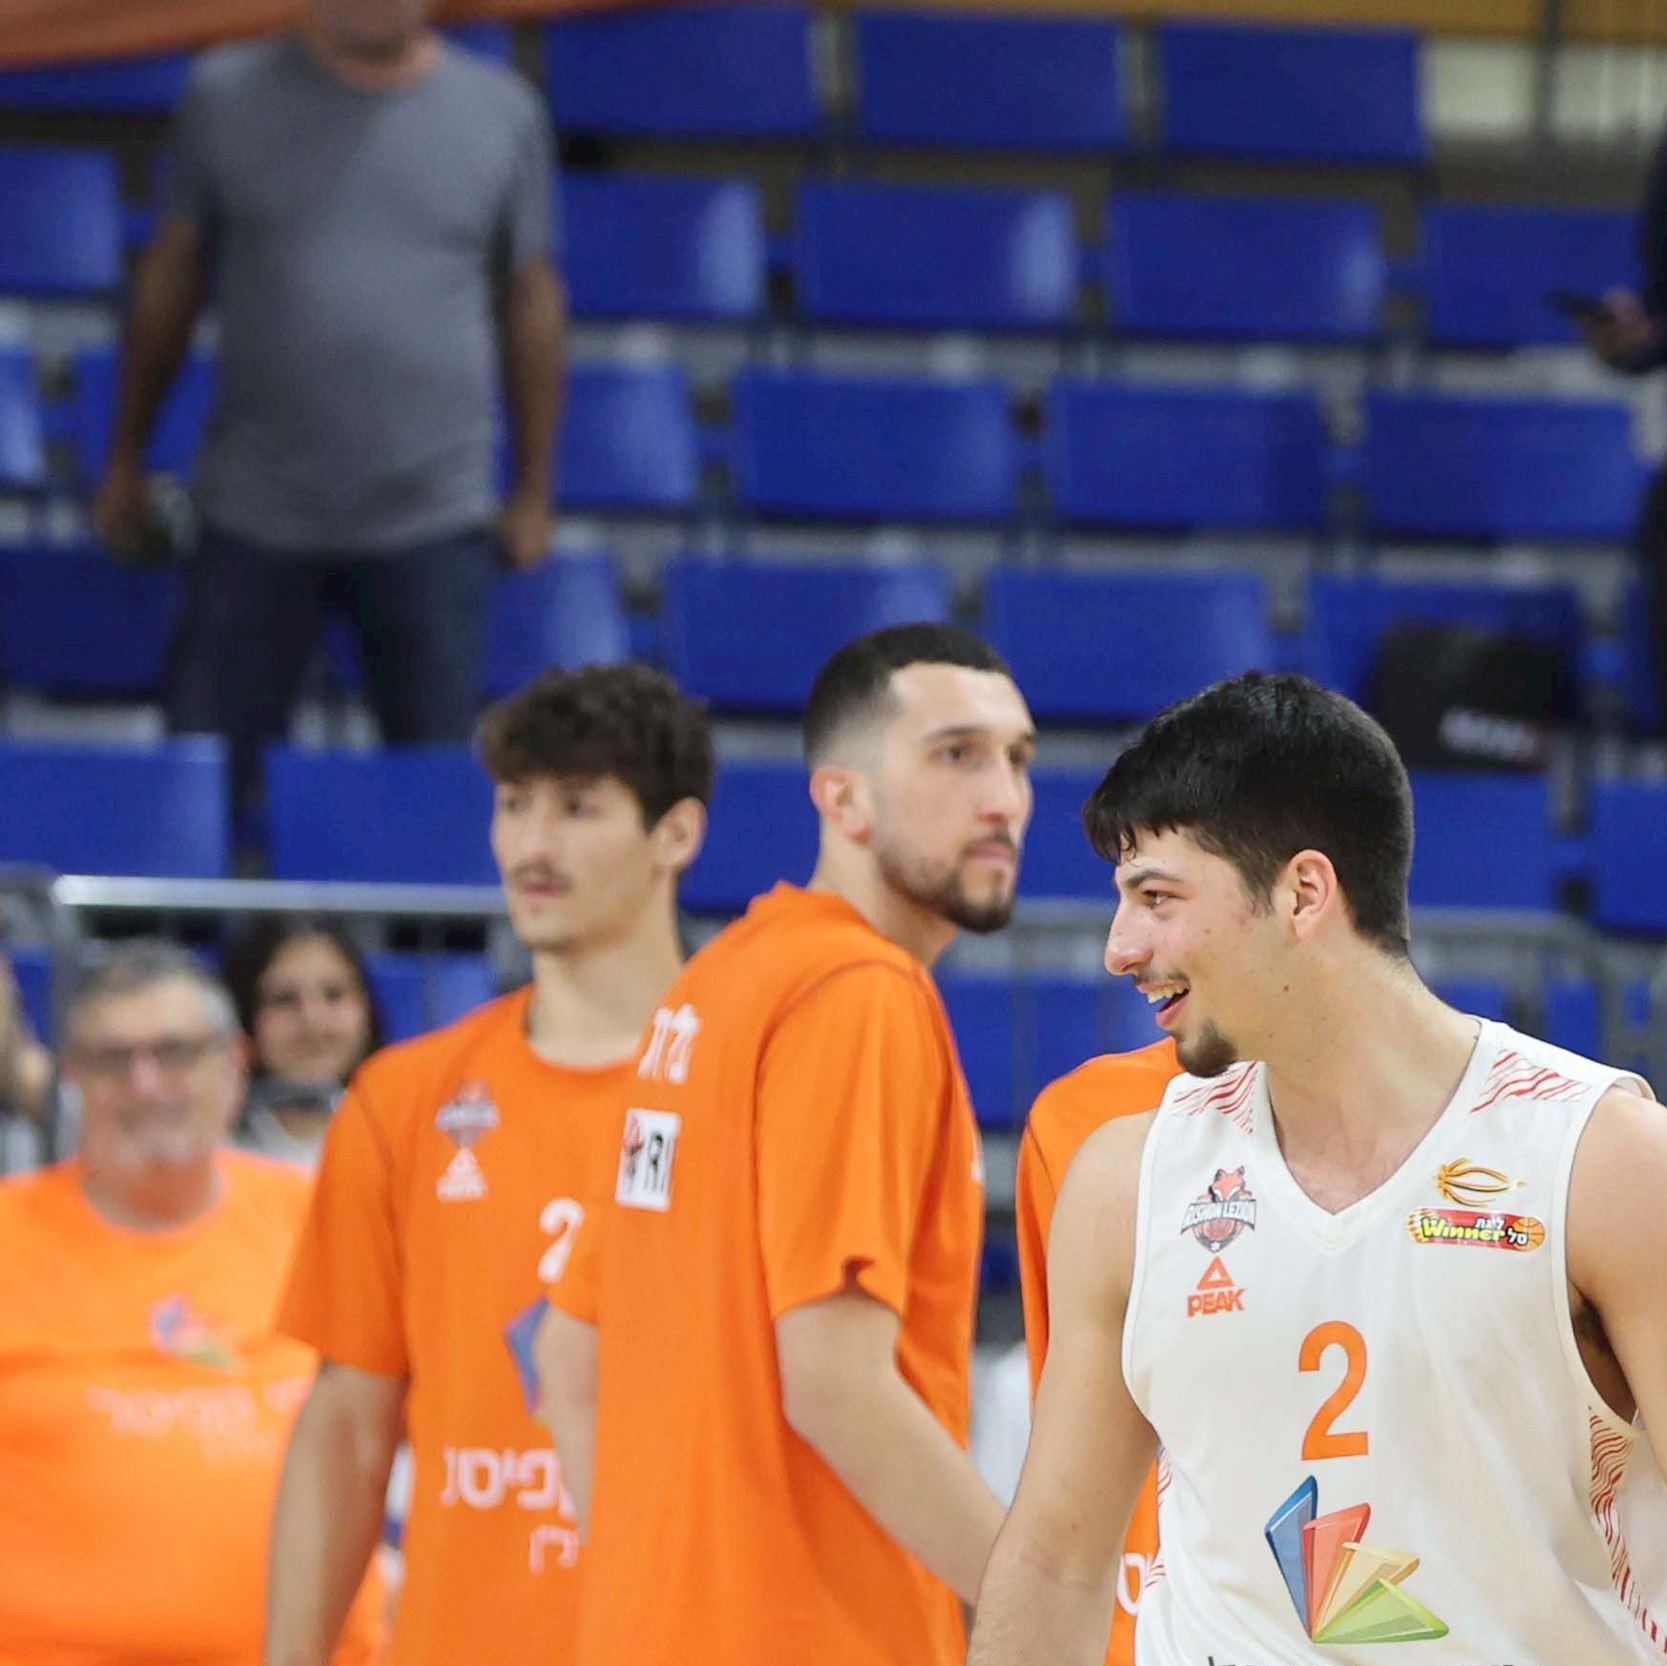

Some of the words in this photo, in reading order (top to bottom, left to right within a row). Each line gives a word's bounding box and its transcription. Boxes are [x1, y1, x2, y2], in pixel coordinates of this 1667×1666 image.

[1421, 1216, 1506, 1242] Winner
[1507, 1228, 1529, 1245] סל
[1187, 1288, 1246, 1318] PEAK
[1298, 1321, 1370, 1462] 2
